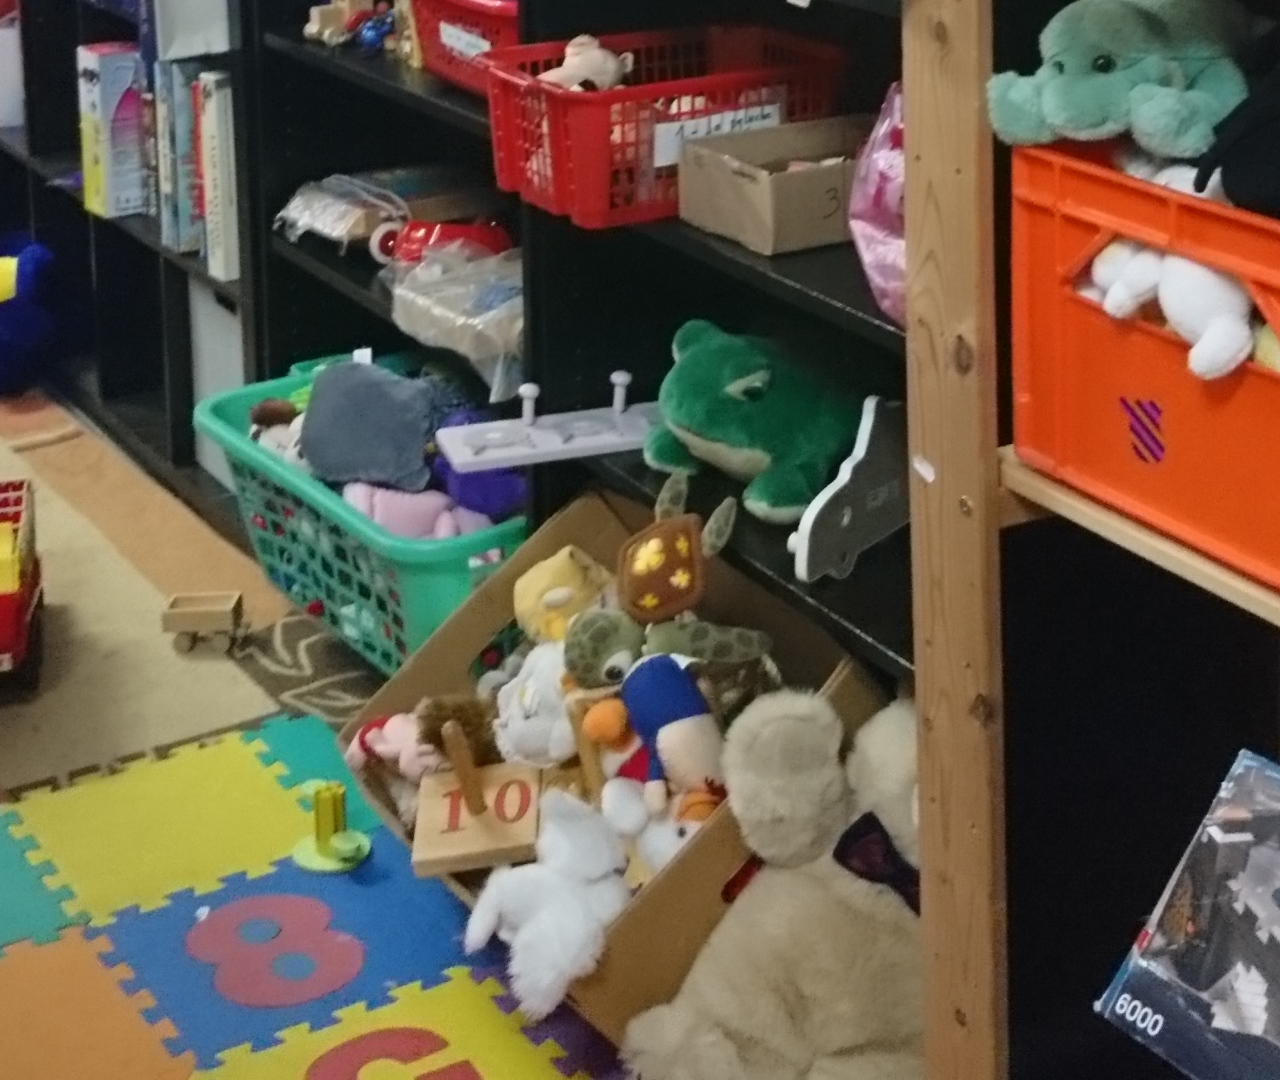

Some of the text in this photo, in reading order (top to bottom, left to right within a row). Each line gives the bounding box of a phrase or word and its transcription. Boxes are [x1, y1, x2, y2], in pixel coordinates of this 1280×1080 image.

[822, 187, 841, 220] 3
[186, 894, 365, 1008] 8
[1115, 993, 1164, 1036] 6000
